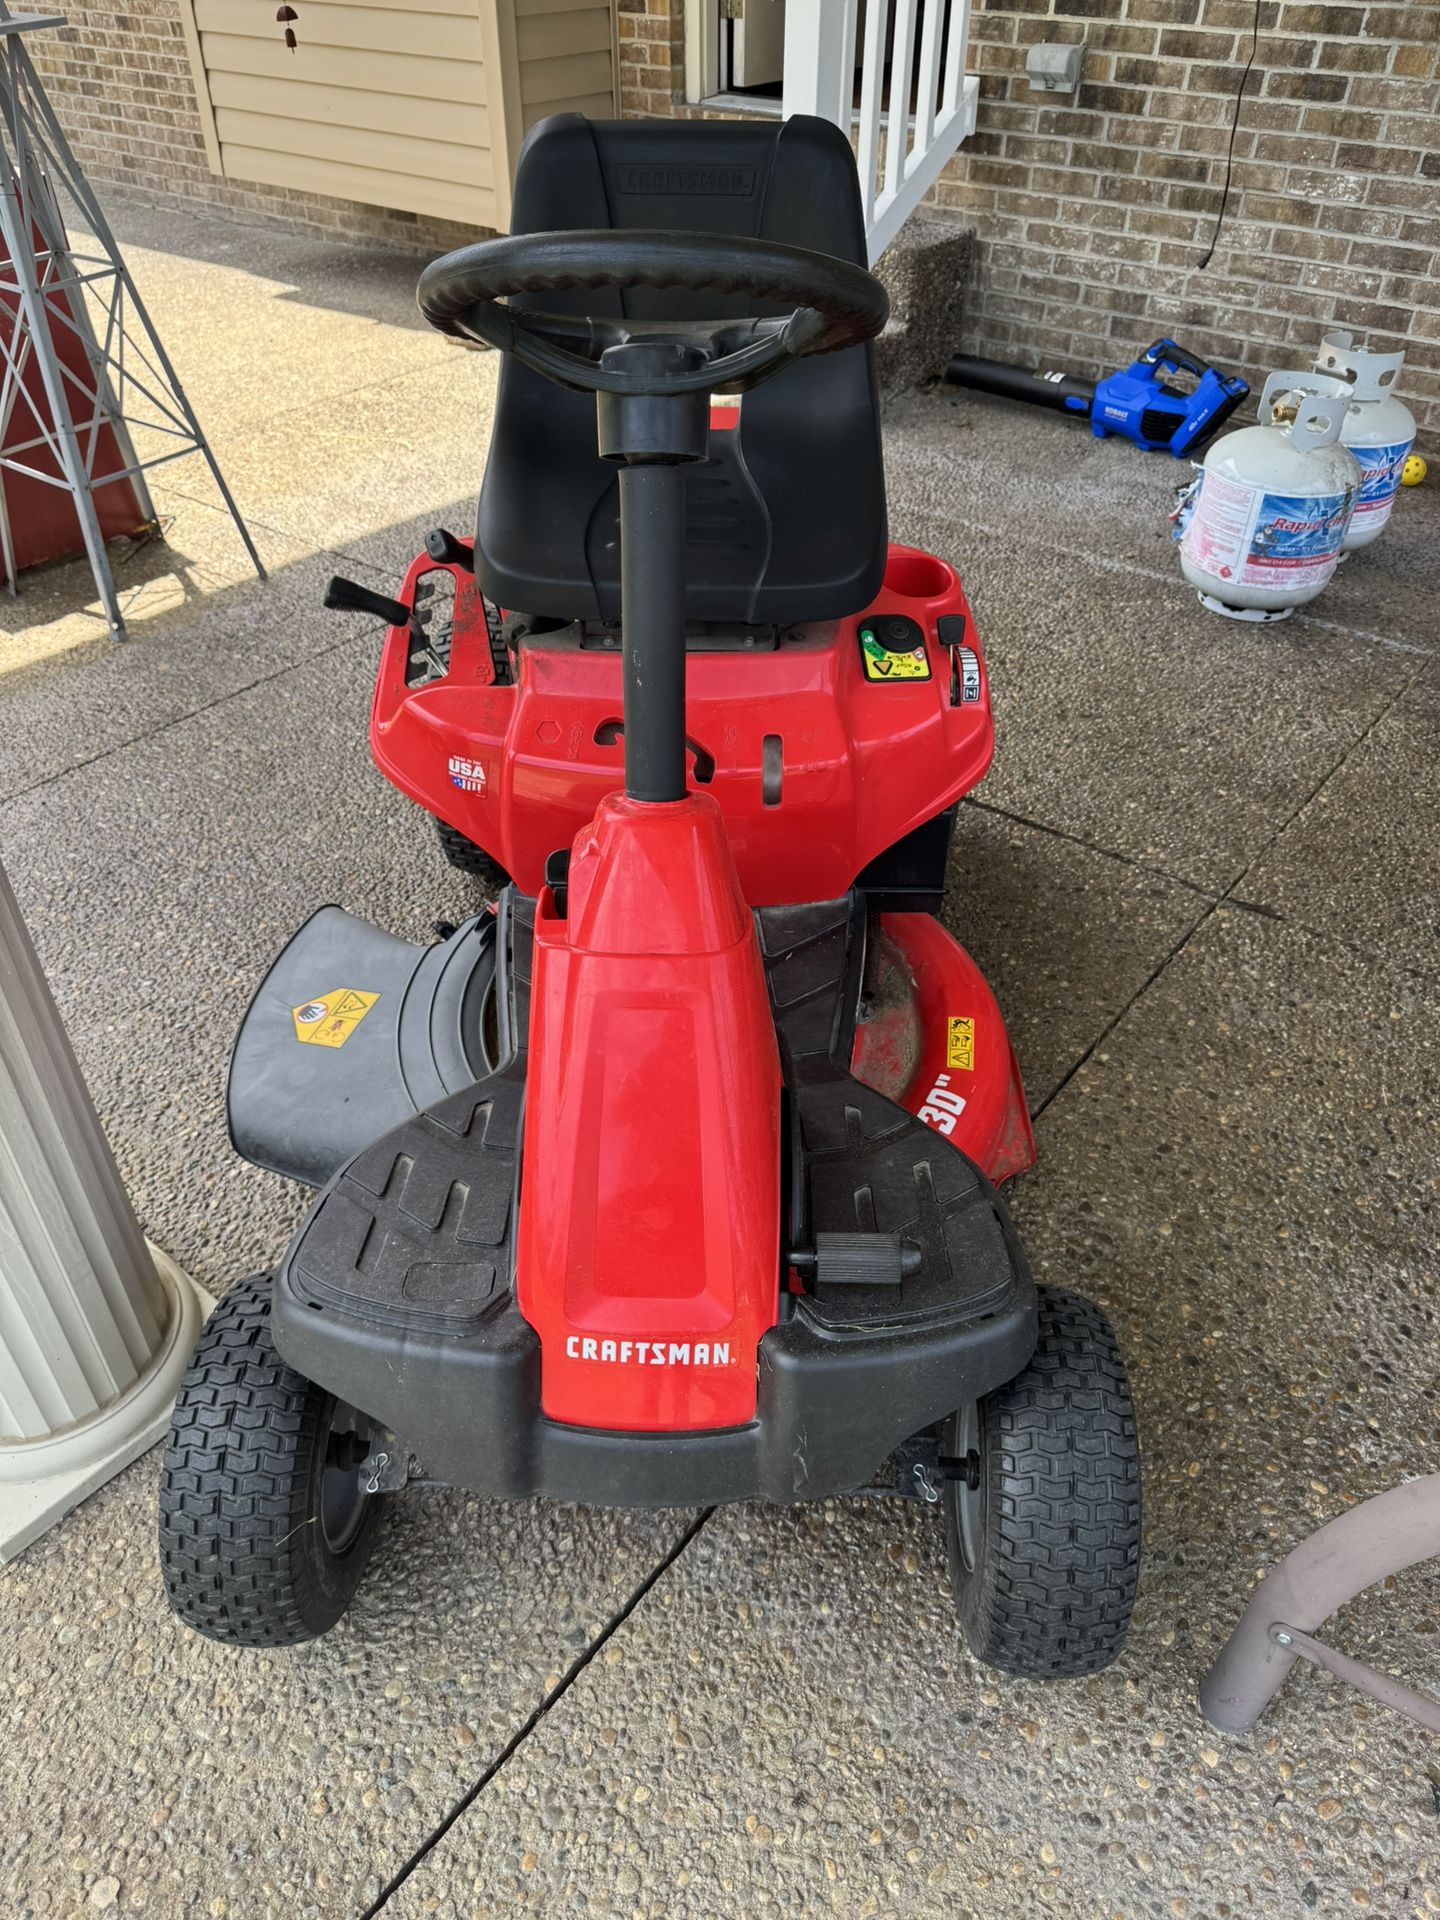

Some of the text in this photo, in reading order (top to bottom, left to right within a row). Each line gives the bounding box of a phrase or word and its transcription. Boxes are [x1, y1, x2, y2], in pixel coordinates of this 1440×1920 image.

[627, 171, 745, 191] CRAFTSMAN
[1272, 516, 1326, 534] Rapid
[448, 758, 486, 781] USA
[917, 1073, 967, 1135] 30"
[566, 1336, 731, 1366] CRAFTSMAN
